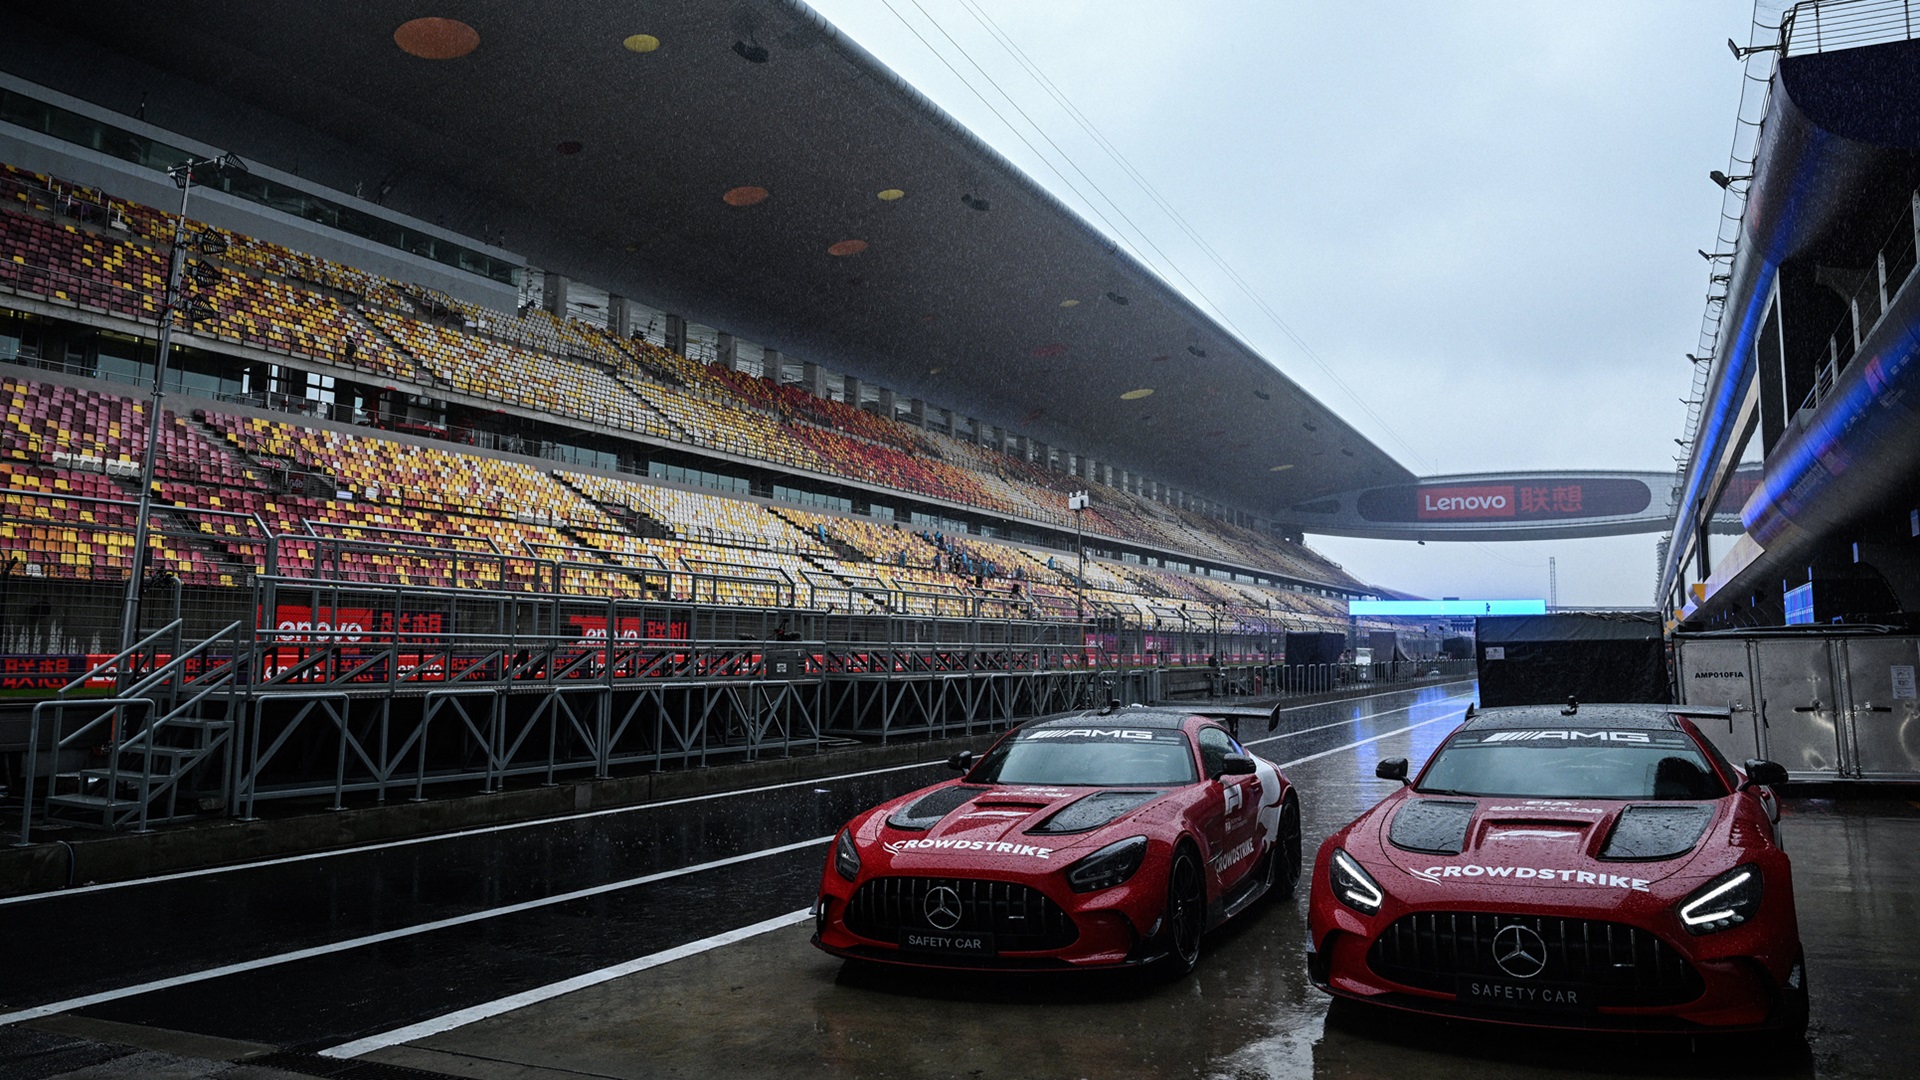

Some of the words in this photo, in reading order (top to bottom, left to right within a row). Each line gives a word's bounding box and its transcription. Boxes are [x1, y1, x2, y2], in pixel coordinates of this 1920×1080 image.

[1425, 494, 1506, 511] Lenovo
[1519, 484, 1583, 513] 联想
[2, 658, 70, 689] 联想
[1694, 671, 1744, 679] AMP010FIA
[1061, 729, 1153, 740] AMG
[1528, 731, 1650, 743] AMG
[891, 839, 1054, 859] CROWDSTRIKE
[1215, 837, 1254, 873] CROWDSTRIKE
[1424, 864, 1650, 893] CROWDSTRIKE
[908, 935, 953, 948] SAFETY
[955, 938, 982, 949] CAR
[1471, 983, 1537, 1001] SAFETY
[1542, 990, 1578, 1003] CAR
